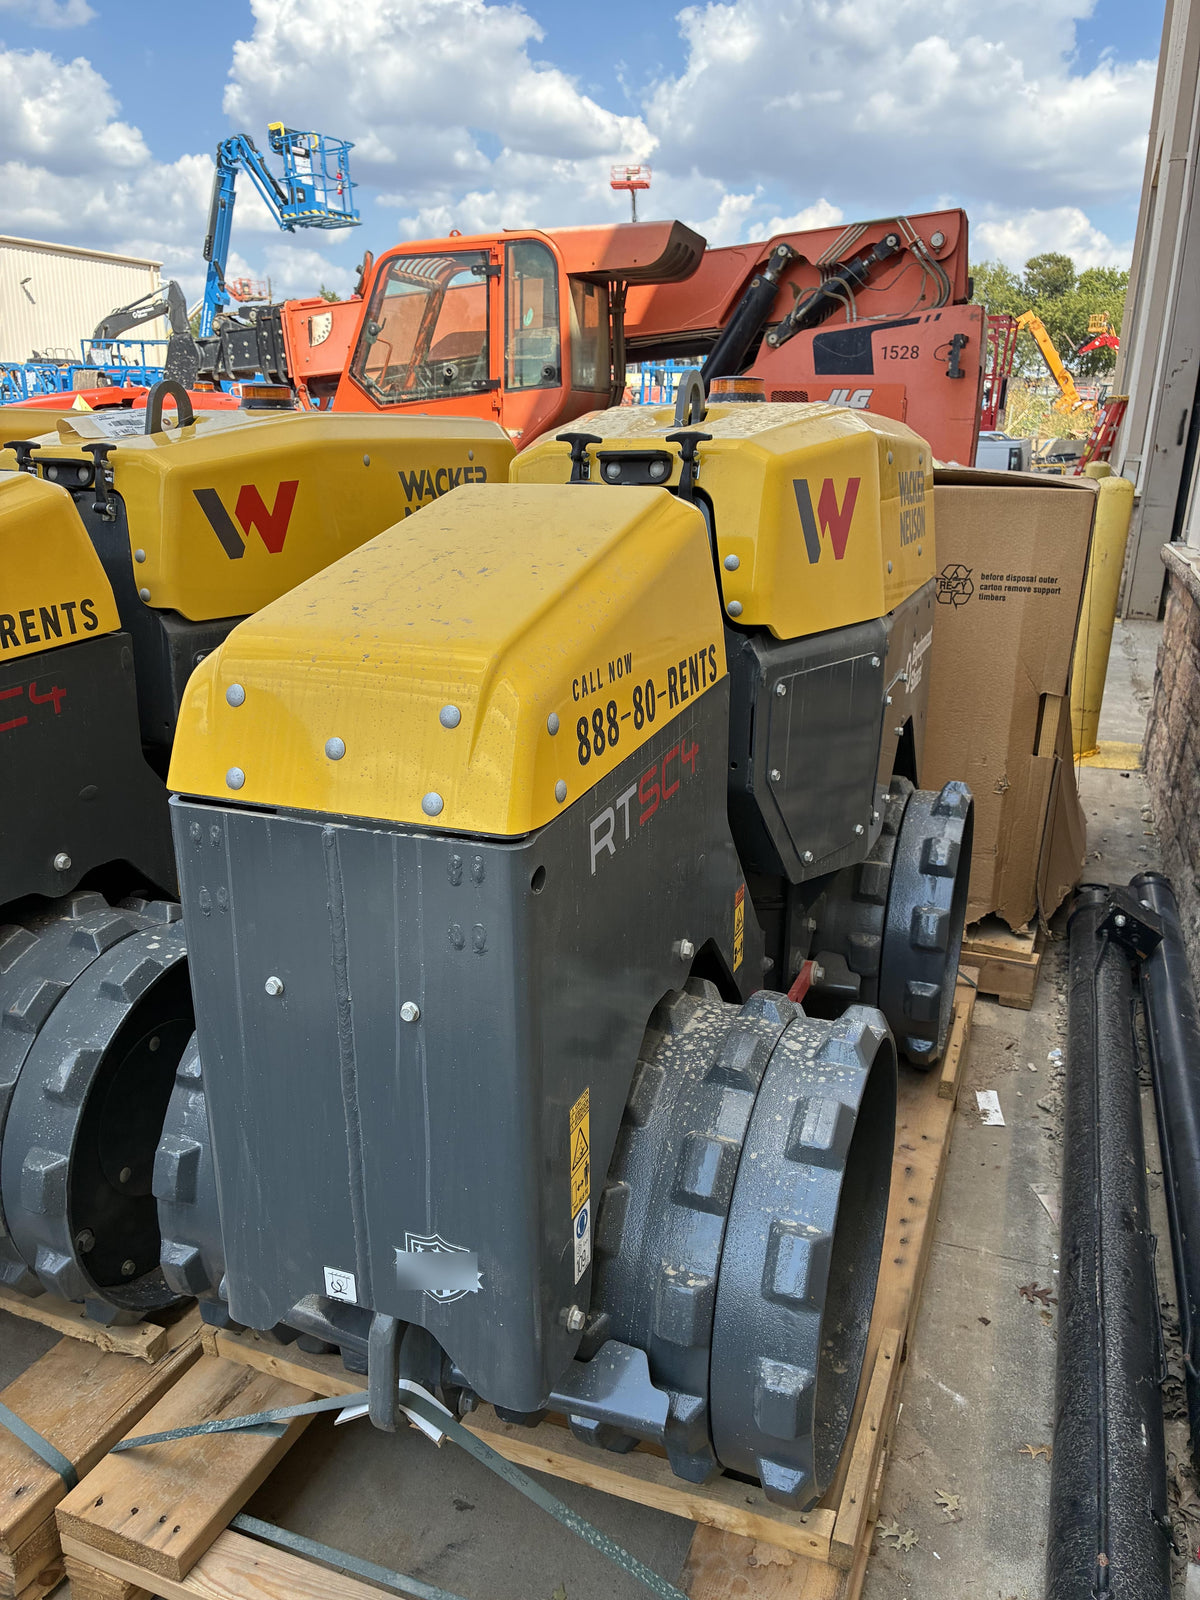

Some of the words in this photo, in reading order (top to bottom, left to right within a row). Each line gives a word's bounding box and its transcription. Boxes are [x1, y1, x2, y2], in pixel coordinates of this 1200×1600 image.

[881, 345, 920, 360] 1528
[827, 388, 874, 409] JLG
[898, 470, 925, 508] WACKER
[899, 505, 925, 548] NEUSON
[979, 583, 1002, 591] carton
[1033, 587, 1061, 595] support
[980, 573, 1004, 581] before
[1005, 574, 1037, 583] disposal
[1038, 576, 1058, 584] outer
[978, 593, 1006, 602] timbers
[572, 668, 604, 702] CALL
[608, 652, 632, 684] NOW
[576, 643, 717, 766] 888-80-RENTS
[589, 738, 700, 876] RTSC4
